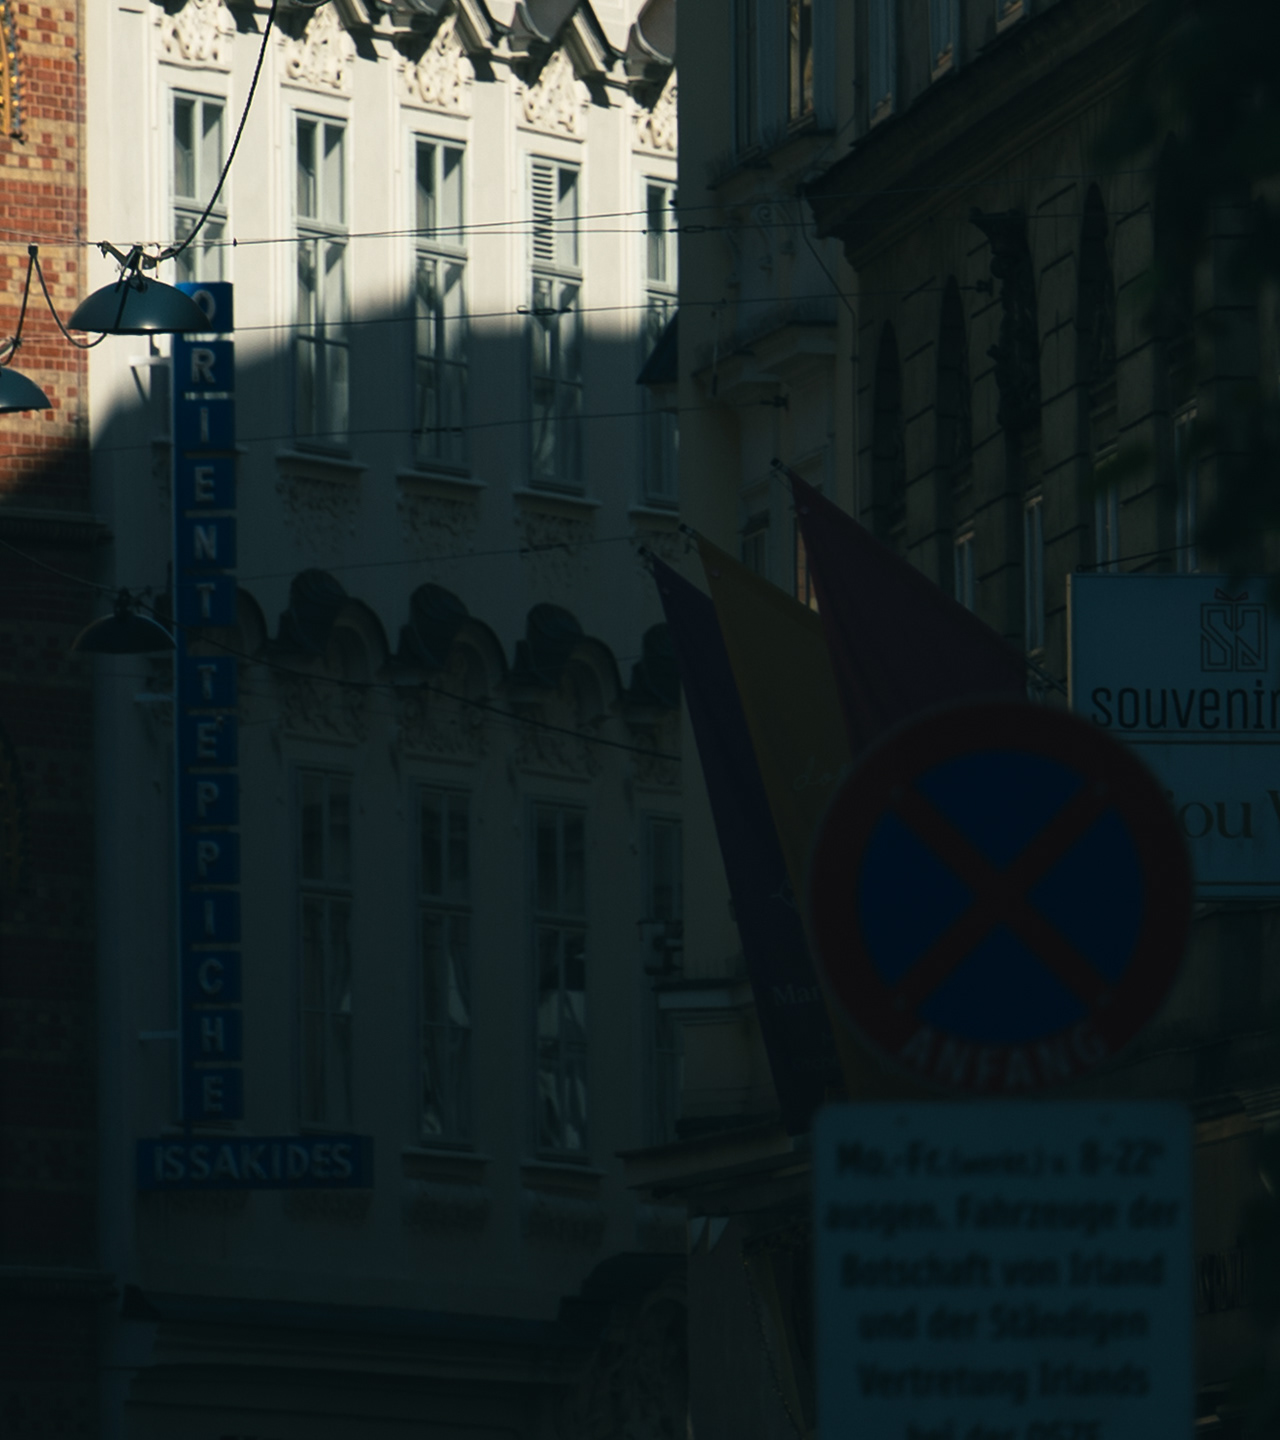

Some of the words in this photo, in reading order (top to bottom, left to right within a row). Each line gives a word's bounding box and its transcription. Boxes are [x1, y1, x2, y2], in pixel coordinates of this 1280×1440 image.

[190, 289, 217, 619] ORIENT
[196, 665, 225, 1113] TEPPICHE
[902, 1023, 1107, 1087] ANFANG
[154, 1143, 353, 1181] ISSAKIDES
